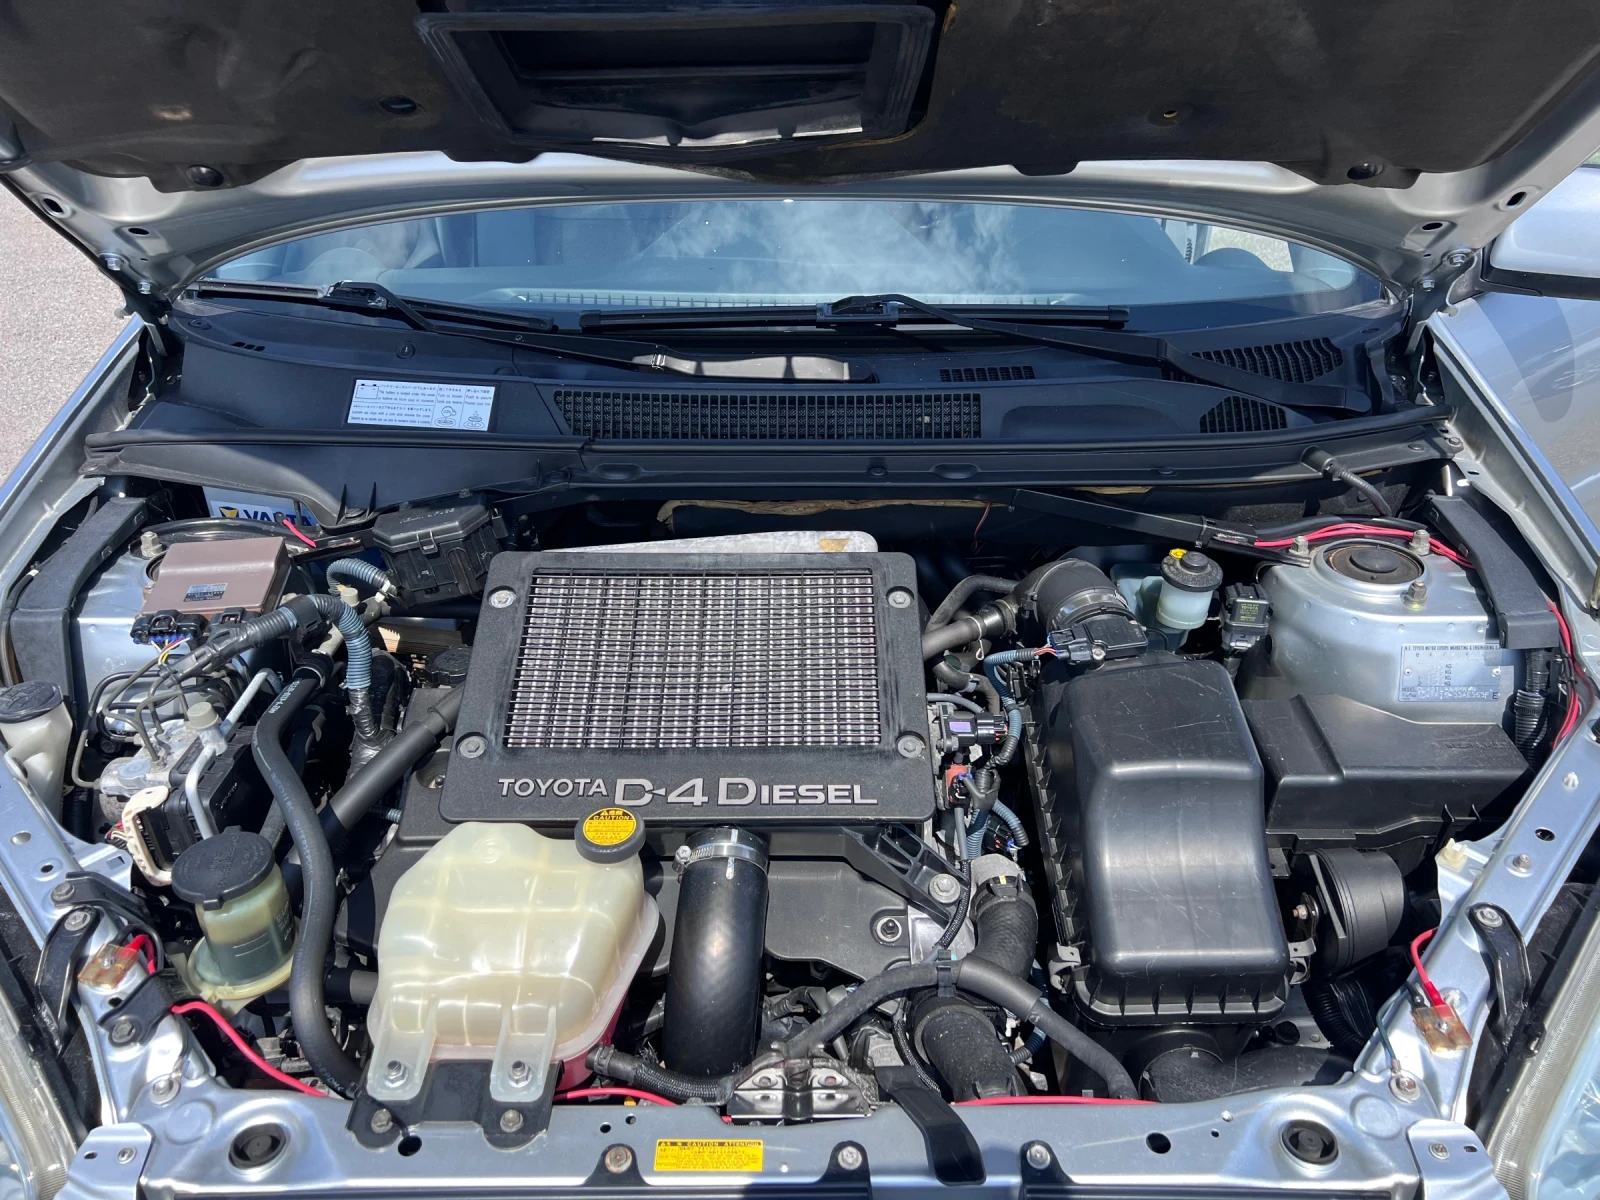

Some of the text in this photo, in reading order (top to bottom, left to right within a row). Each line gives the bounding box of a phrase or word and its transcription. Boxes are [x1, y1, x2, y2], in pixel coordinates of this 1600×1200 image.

[243, 509, 312, 526] VATA
[498, 776, 878, 805] TOYOTA D-4 DIESEL
